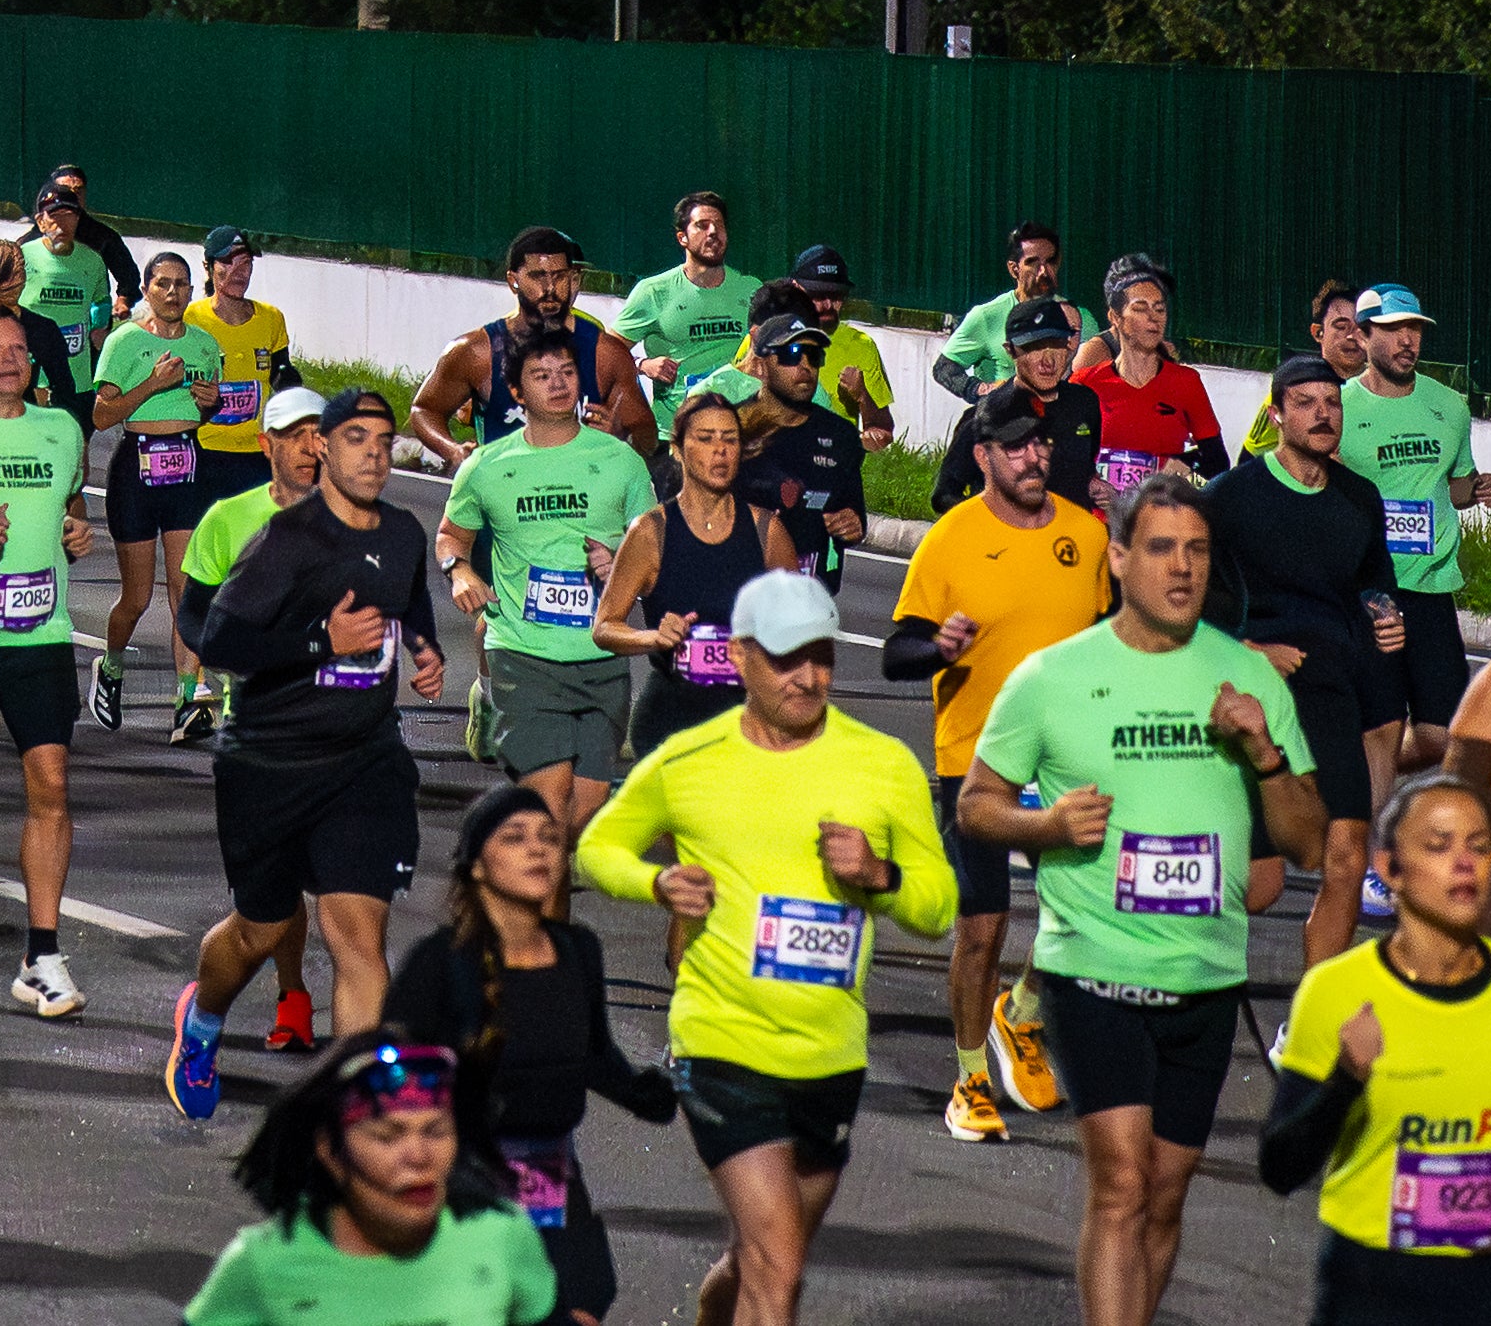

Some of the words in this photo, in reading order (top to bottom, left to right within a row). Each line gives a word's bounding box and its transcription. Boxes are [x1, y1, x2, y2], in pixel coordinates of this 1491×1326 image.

[689, 321, 743, 337] ATHENAS
[159, 453, 185, 469] 548
[1376, 438, 1442, 462] ATHENAS
[516, 492, 589, 515] ATHENAS
[1386, 515, 1427, 535] 2692
[10, 587, 52, 609] 2082
[544, 586, 590, 608] 3019
[1152, 860, 1202, 886] 840
[786, 922, 852, 957] 2829
